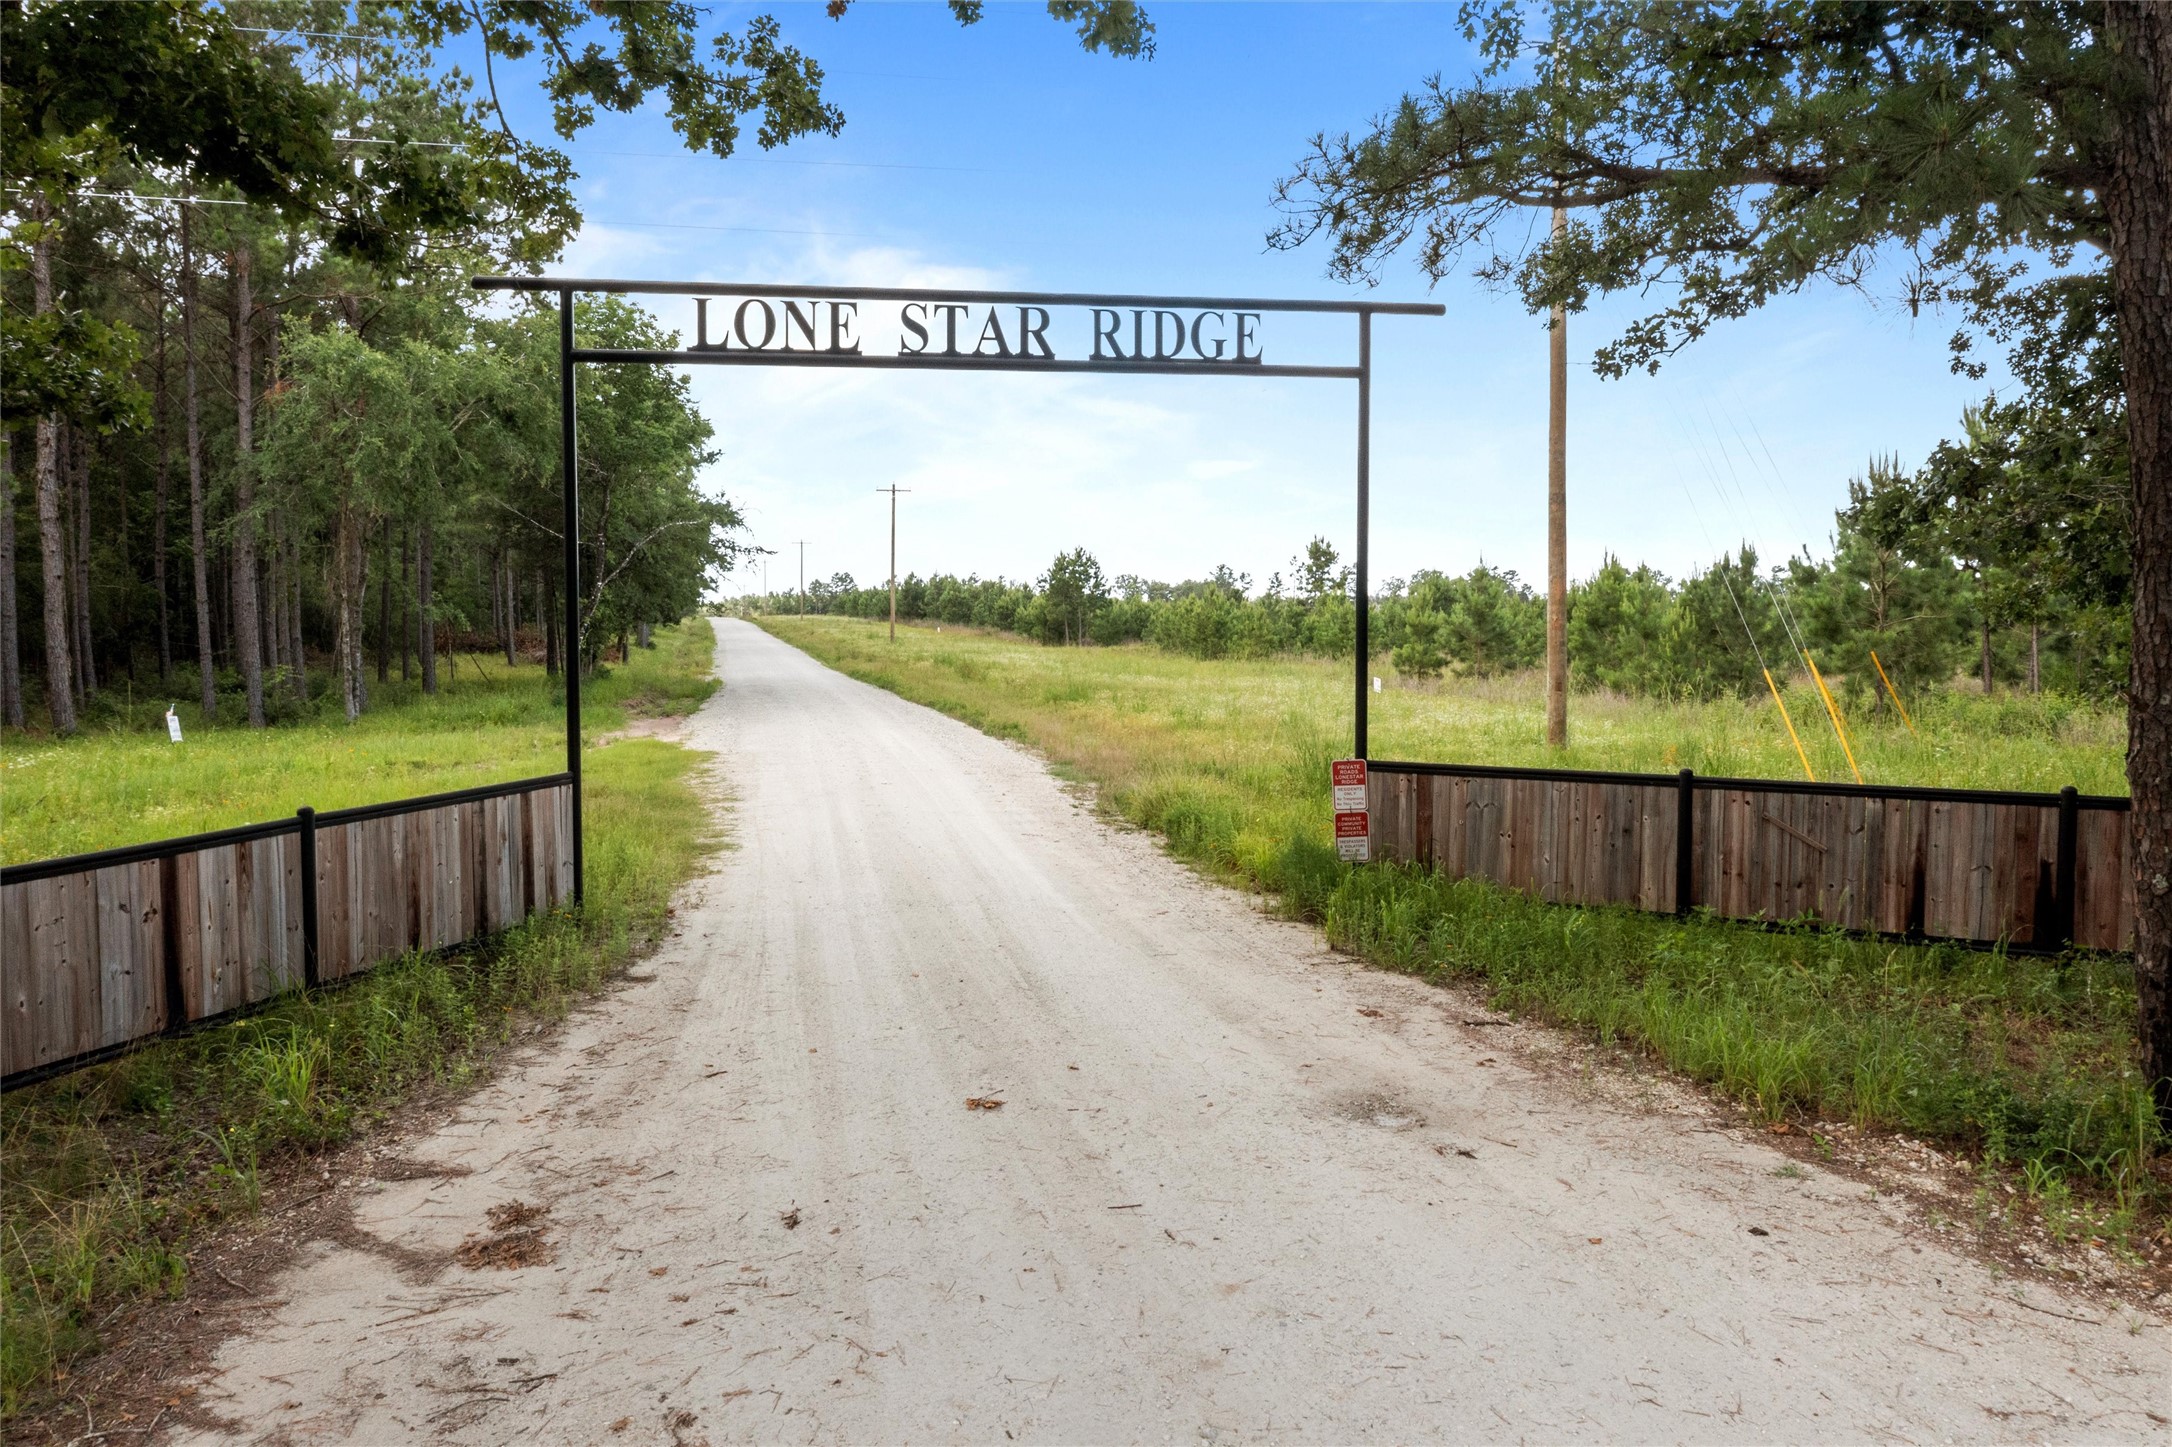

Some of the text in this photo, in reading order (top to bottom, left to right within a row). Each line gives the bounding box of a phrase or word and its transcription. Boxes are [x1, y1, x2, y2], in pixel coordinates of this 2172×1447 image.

[687, 297, 1263, 363] LONE STAR RIDGE
